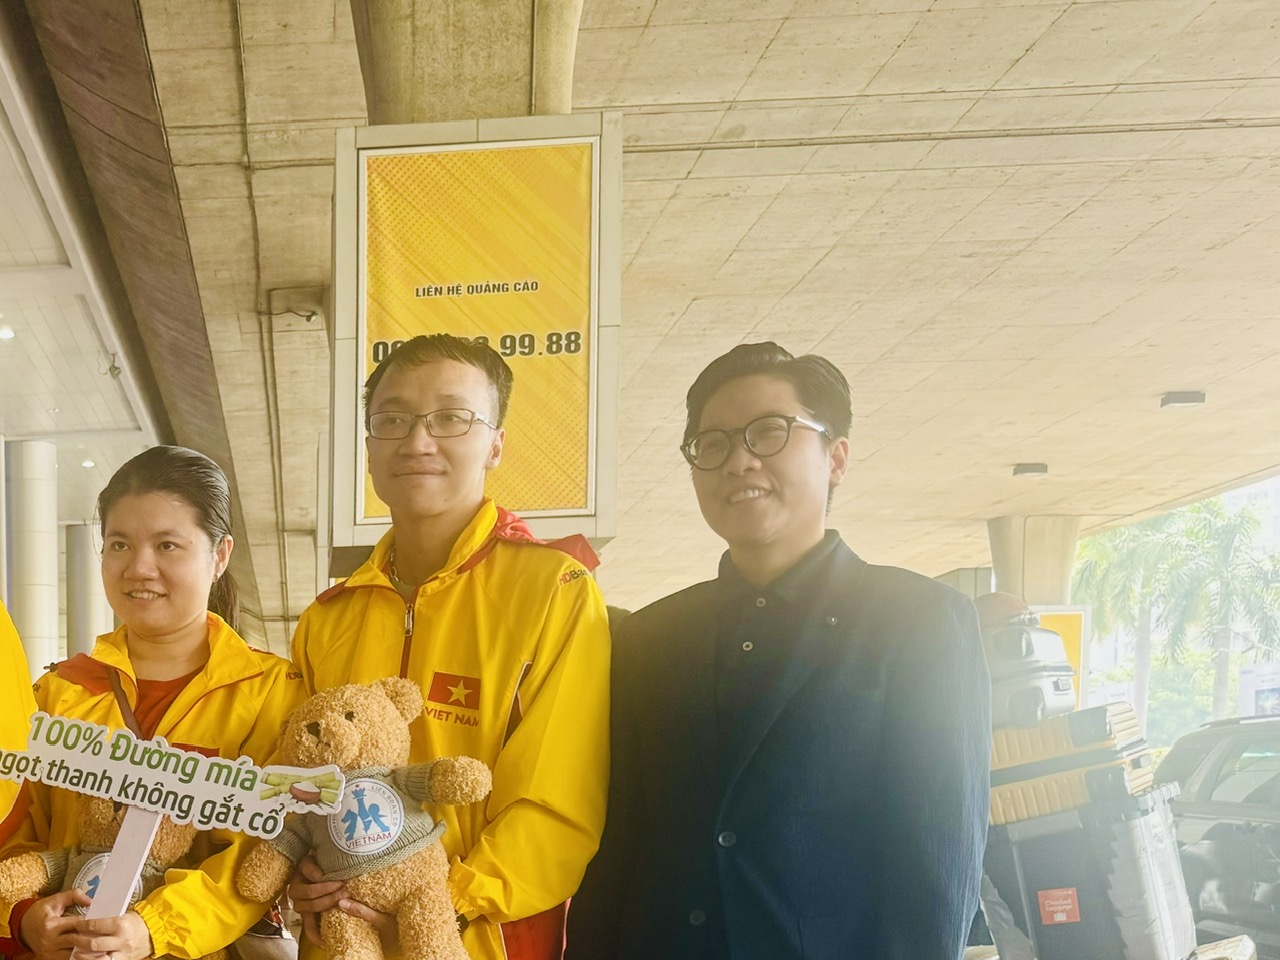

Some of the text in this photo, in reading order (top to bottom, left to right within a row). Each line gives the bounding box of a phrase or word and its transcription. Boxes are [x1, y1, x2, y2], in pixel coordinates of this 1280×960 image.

[415, 280, 539, 298] LIÊN HỆ QUẢNG CÁO
[424, 706, 480, 727] VIET NAM
[31, 716, 258, 791] 100% Đường mía
[46, 759, 113, 795] thanh
[117, 774, 195, 820] không
[198, 793, 244, 827] gắt
[248, 802, 285, 835] cổ
[345, 831, 392, 849] VIETNAM
